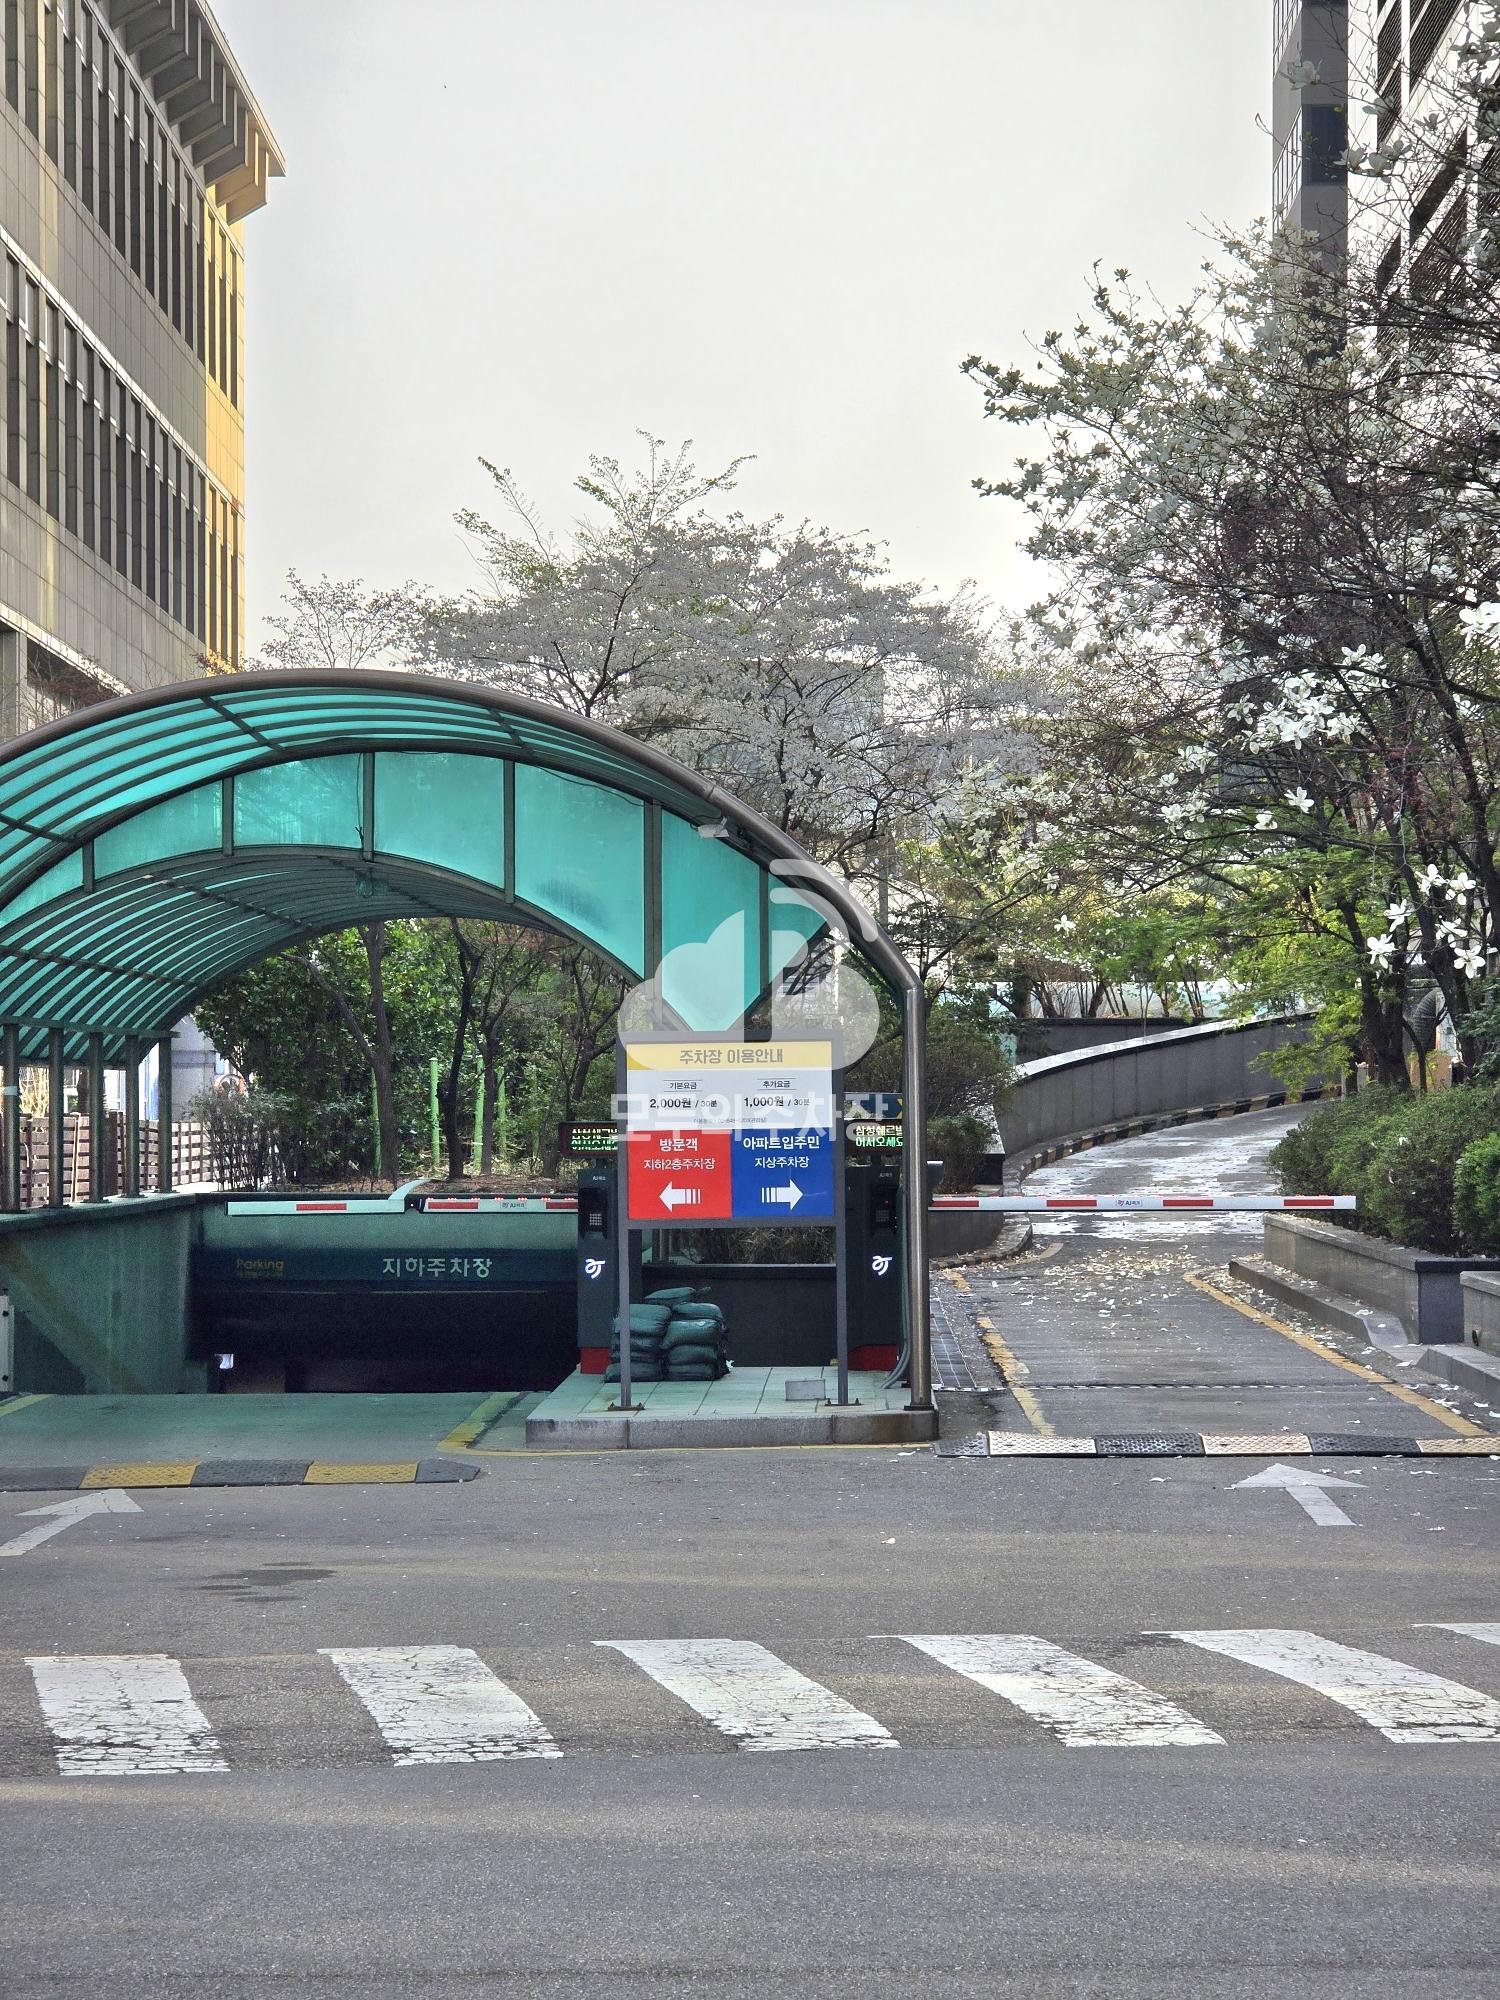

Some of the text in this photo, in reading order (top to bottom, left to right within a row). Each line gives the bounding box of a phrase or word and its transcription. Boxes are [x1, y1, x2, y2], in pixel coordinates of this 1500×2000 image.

[680, 1048, 783, 1064] 주차장 이용안내
[670, 1081, 697, 1090] 기본요금
[762, 1080, 791, 1089] 추가요금
[649, 1098, 691, 1109] 2,000원
[743, 1095, 784, 1108] 1,000원
[659, 1137, 698, 1152] 방문객
[743, 1135, 820, 1150] 아파트입주민
[643, 1157, 716, 1170] 지하2층주차장
[754, 1155, 810, 1168] 지상주차장
[235, 1258, 285, 1271] Parking
[382, 1257, 493, 1278] 지하주차장
